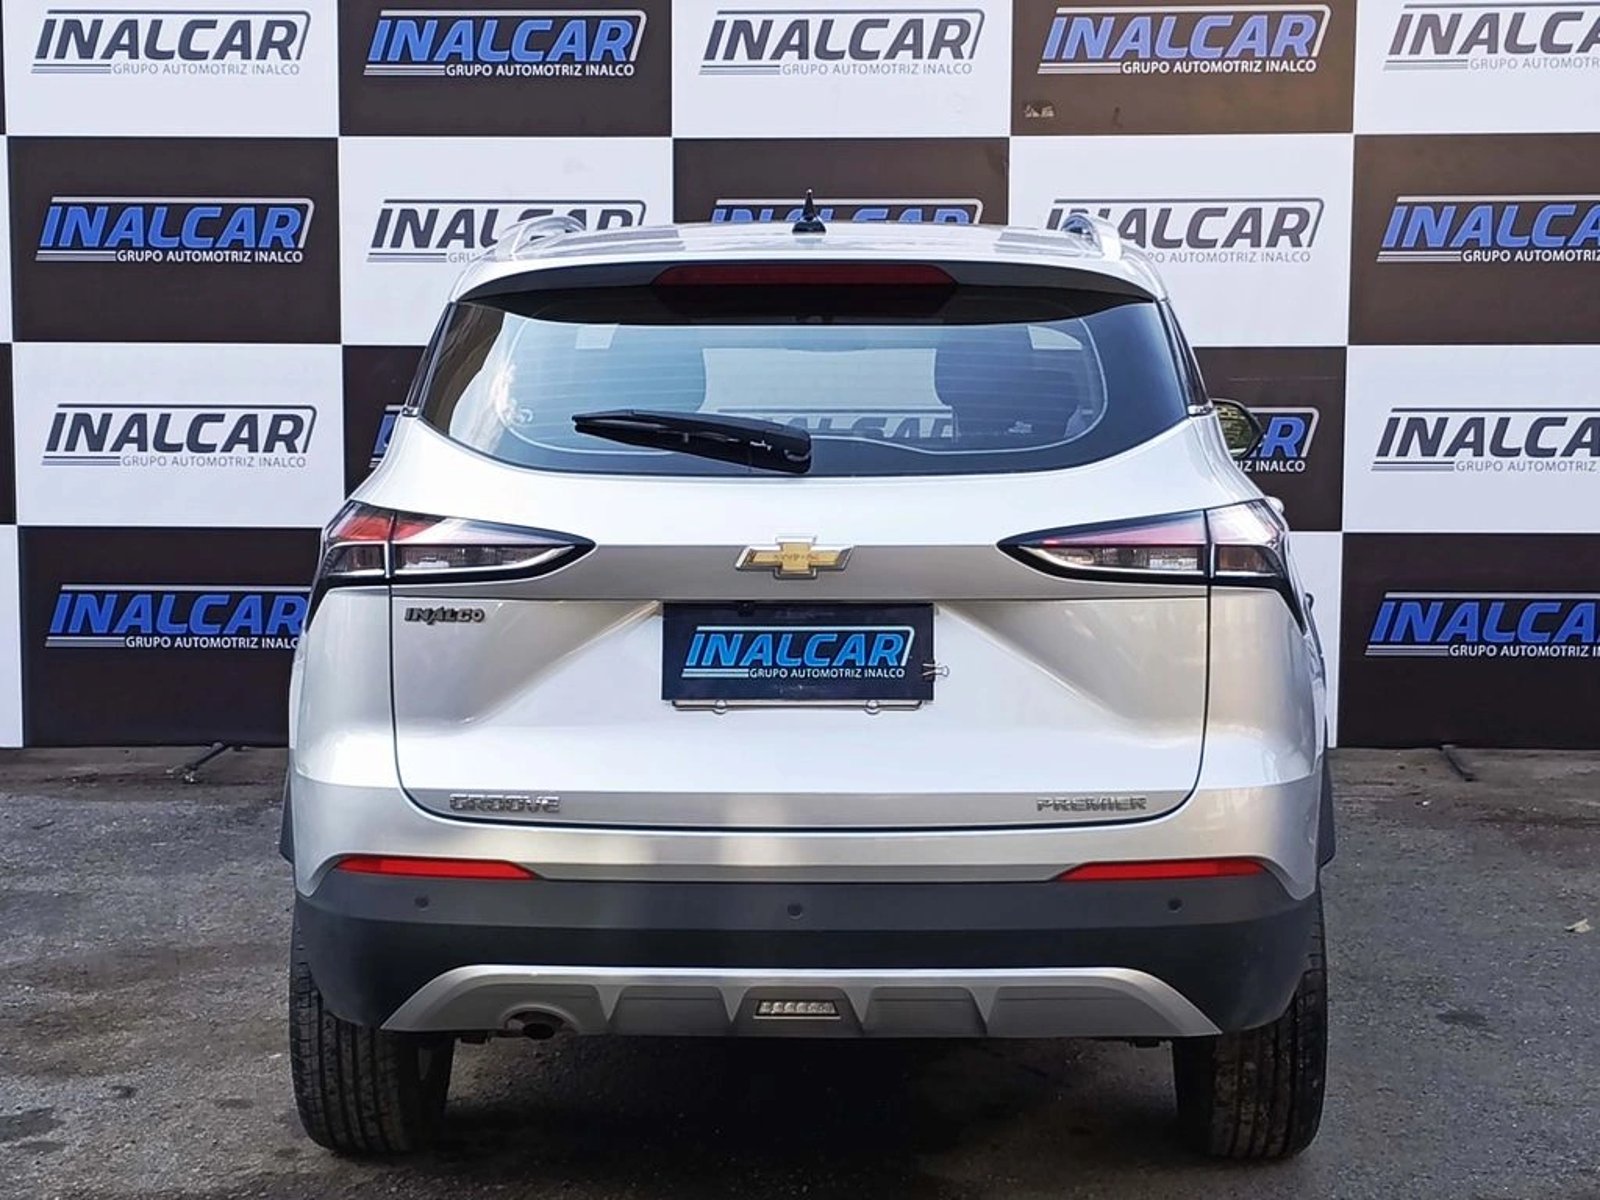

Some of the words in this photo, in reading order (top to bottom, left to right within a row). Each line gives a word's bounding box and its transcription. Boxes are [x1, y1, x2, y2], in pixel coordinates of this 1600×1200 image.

[34, 18, 298, 61] INALCAR
[367, 19, 634, 62] INALCAR
[703, 18, 971, 61] INALCAR
[1041, 14, 1317, 60] INALCAR
[113, 63, 159, 75] GRUPO
[163, 63, 247, 75] AUTOMOTRIZ
[252, 63, 300, 76] INALCO
[446, 64, 493, 76] GRUPO
[496, 64, 582, 76] AUTOMOTRIZ
[585, 64, 634, 76] INALCO
[782, 63, 828, 75] GRUPO
[832, 63, 919, 75] AUTOMOTRIZ
[922, 63, 972, 75] INALCO
[1122, 61, 1170, 74] GRUPO
[1173, 60, 1262, 73] AUTOMOTRIZ
[1265, 59, 1317, 73] INALCO
[1470, 58, 1518, 70] GRUPO
[39, 206, 301, 248] INALCAR
[1046, 207, 1311, 249] IALCAR
[117, 250, 163, 262] GRUPO
[166, 250, 252, 262] AUTOMOTRIZ
[254, 250, 303, 263] INALCO
[1170, 251, 1257, 263] AUTOMOTRIZ
[1261, 251, 1311, 263] INALCO
[1463, 250, 1511, 262] GRUPO
[45, 412, 304, 454] INALCAR
[122, 455, 167, 467] GRUPO
[171, 455, 255, 468] AUTOMOTRIZ
[258, 456, 306, 468] INALCO
[1256, 460, 1306, 472] INALCO
[1456, 460, 1503, 472] GRUPO
[1507, 460, 1597, 472] AUTOMOTRIZ
[50, 593, 306, 635] INALCAR
[1369, 601, 1600, 643] INALCA
[126, 636, 171, 649] GRUPO
[174, 636, 259, 649] AUTOMOTRIZ
[262, 637, 299, 649] INALC
[685, 633, 904, 667] INALCAR
[1450, 644, 1497, 657] GRUPO
[1500, 644, 1589, 657] AUTOMOTRIZ
[749, 668, 788, 678] GRUPO
[790, 667, 862, 678] AUTOMOTRIZ
[864, 667, 905, 678] INALCO
[450, 794, 559, 813] GROOVE
[1037, 796, 1148, 811] PREMIER
